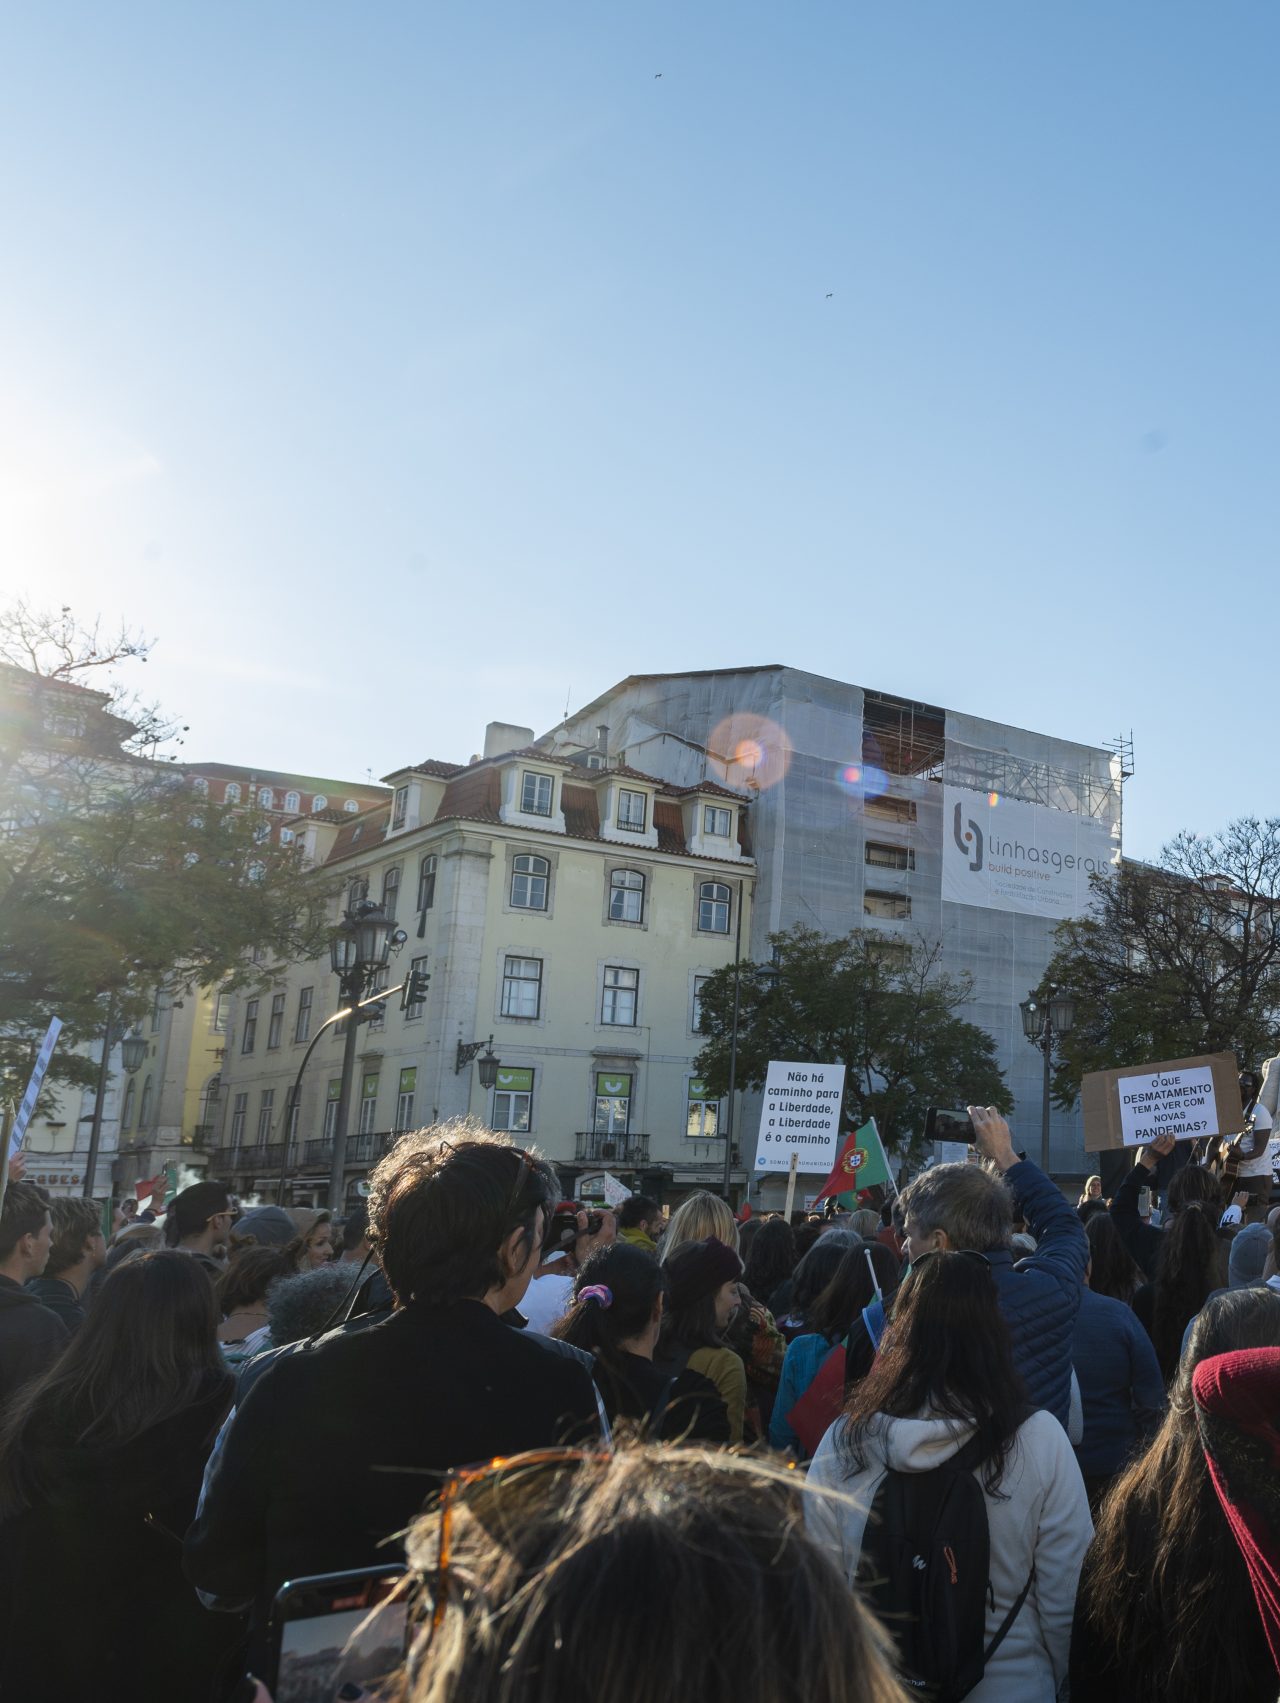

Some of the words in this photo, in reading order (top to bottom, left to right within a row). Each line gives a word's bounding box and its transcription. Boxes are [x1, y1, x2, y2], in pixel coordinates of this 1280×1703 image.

[989, 835, 1109, 875] linhasgerais
[988, 862, 1012, 875] build
[1014, 867, 1051, 881] positive
[788, 1071, 808, 1082] Não
[811, 1072, 824, 1083] há
[1151, 1079, 1159, 1088] O
[1161, 1076, 1181, 1086] QUE
[768, 1087, 813, 1098] caminho
[816, 1089, 840, 1100] para
[1123, 1084, 1212, 1104] DESMATAMENTO
[769, 1103, 775, 1111] a
[779, 1102, 834, 1115] Liberdade,
[1132, 1104, 1152, 1114] TEM
[1154, 1103, 1160, 1111] A
[1162, 1101, 1181, 1110] VER
[1183, 1097, 1205, 1107] COM
[768, 1118, 775, 1126] a
[779, 1117, 831, 1129] Liberdade
[1154, 1111, 1186, 1123] NOVAS
[1135, 1120, 1208, 1139] PANDEMIAS?
[765, 1132, 772, 1142] é
[775, 1134, 782, 1142] o
[785, 1133, 831, 1144] caminho
